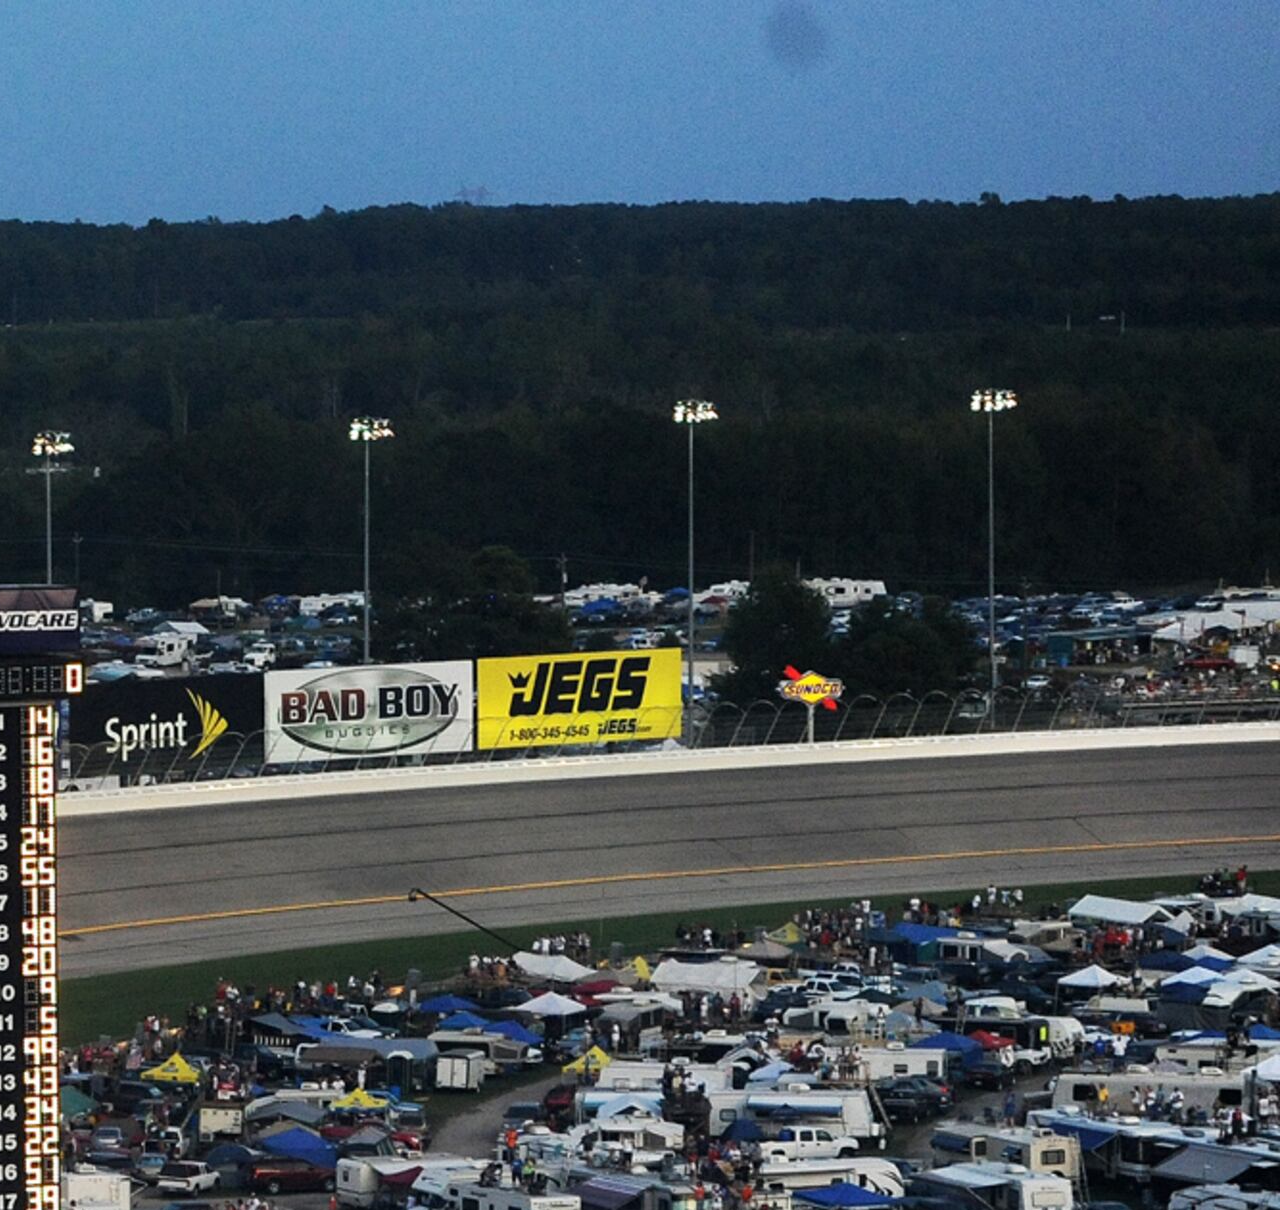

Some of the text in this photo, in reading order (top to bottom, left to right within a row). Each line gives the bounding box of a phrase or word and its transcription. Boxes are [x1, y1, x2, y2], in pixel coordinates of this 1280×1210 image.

[509, 657, 651, 717] JEGS
[788, 683, 839, 695] SUNOCO
[281, 683, 458, 725] BAD BOY
[29, 706, 53, 735] 14
[325, 725, 410, 739] BUGGIES
[29, 736, 54, 765] 16
[105, 712, 188, 762] Sprint
[29, 766, 54, 795] 18
[30, 797, 54, 825] 17
[21, 826, 55, 855] 24
[21, 856, 55, 886] 55
[31, 887, 55, 915] 11
[22, 916, 56, 945] 48
[22, 947, 56, 975] 20
[41, 977, 56, 1004] 9
[41, 1006, 57, 1034] 5
[24, 1036, 57, 1065] 99
[24, 1096, 58, 1125] 34
[24, 1126, 58, 1154] 22
[26, 1155, 59, 1184] 51
